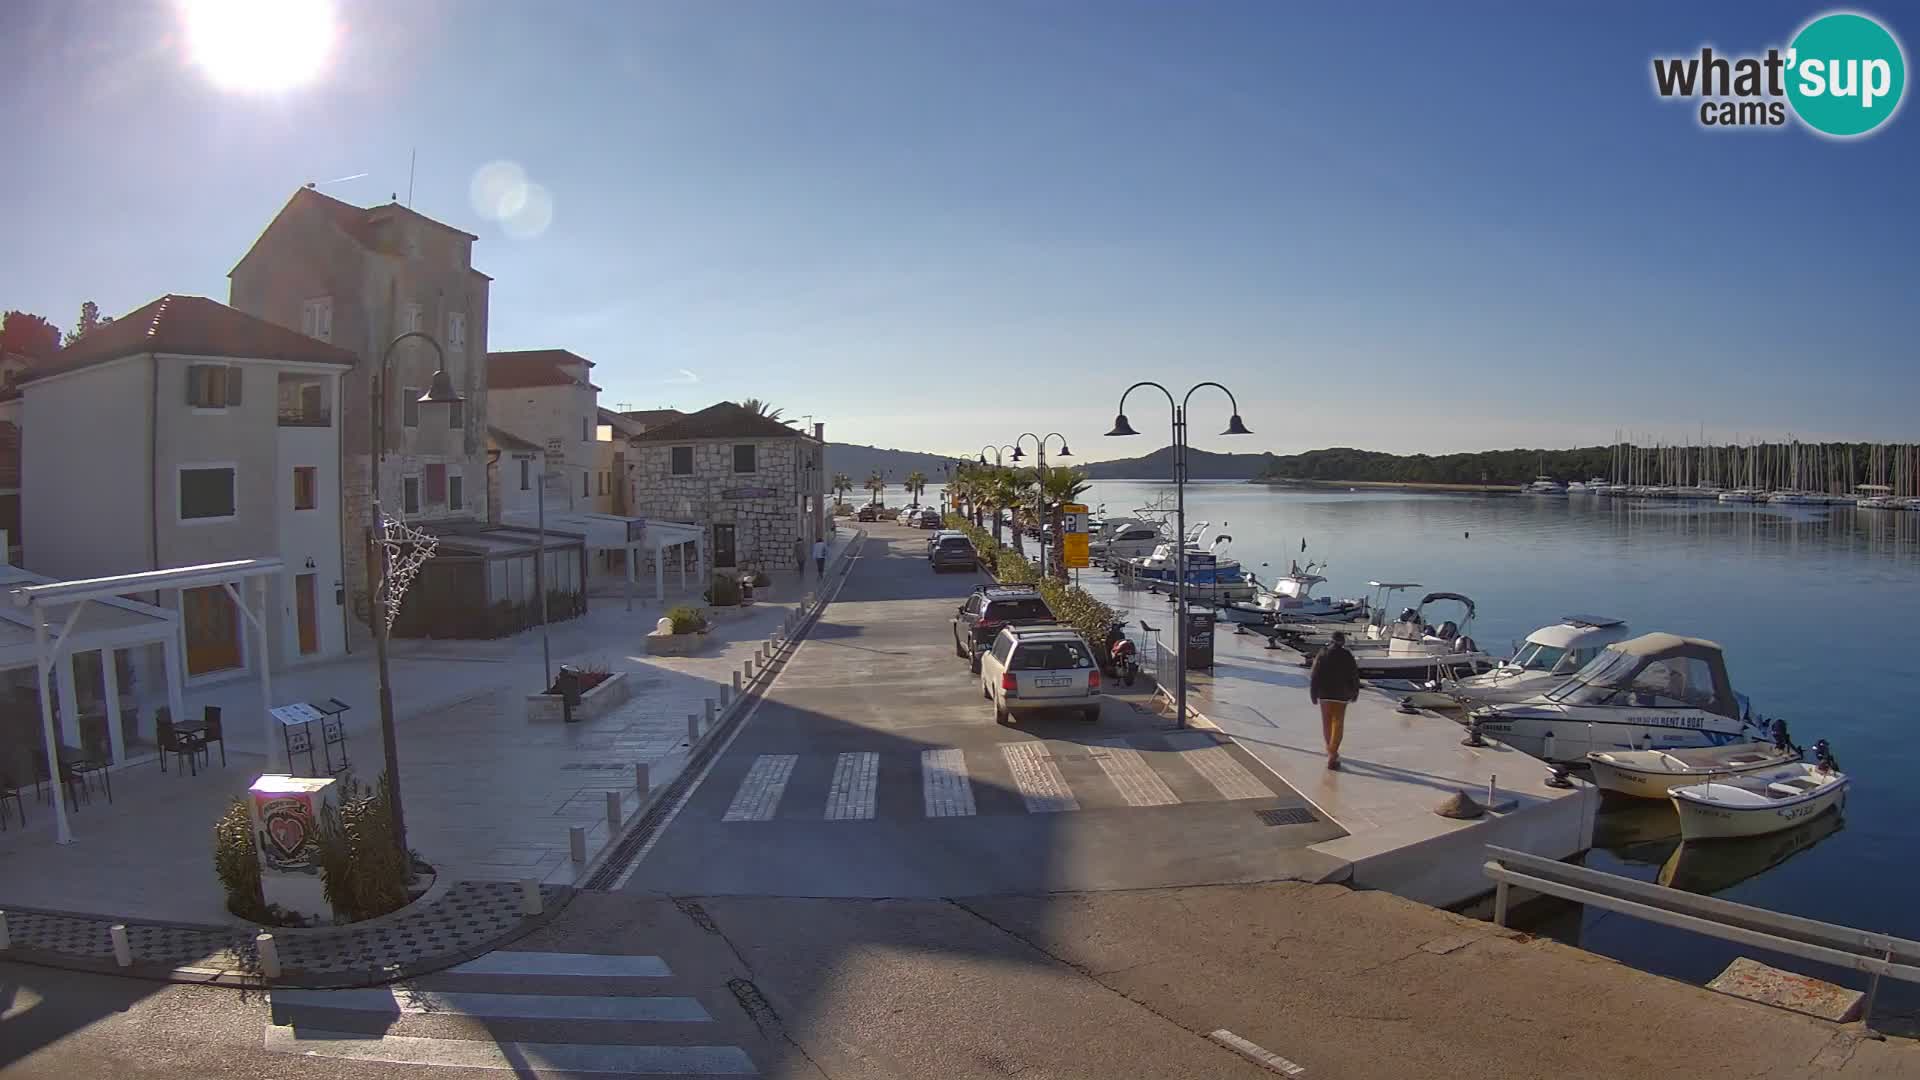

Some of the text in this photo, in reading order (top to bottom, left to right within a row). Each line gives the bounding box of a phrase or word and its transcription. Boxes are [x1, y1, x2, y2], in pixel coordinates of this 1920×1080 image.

[1066, 515, 1076, 531] P
[1660, 717, 1680, 727] RENT
[1681, 717, 1686, 728] A
[1687, 717, 1704, 728] BOAT
